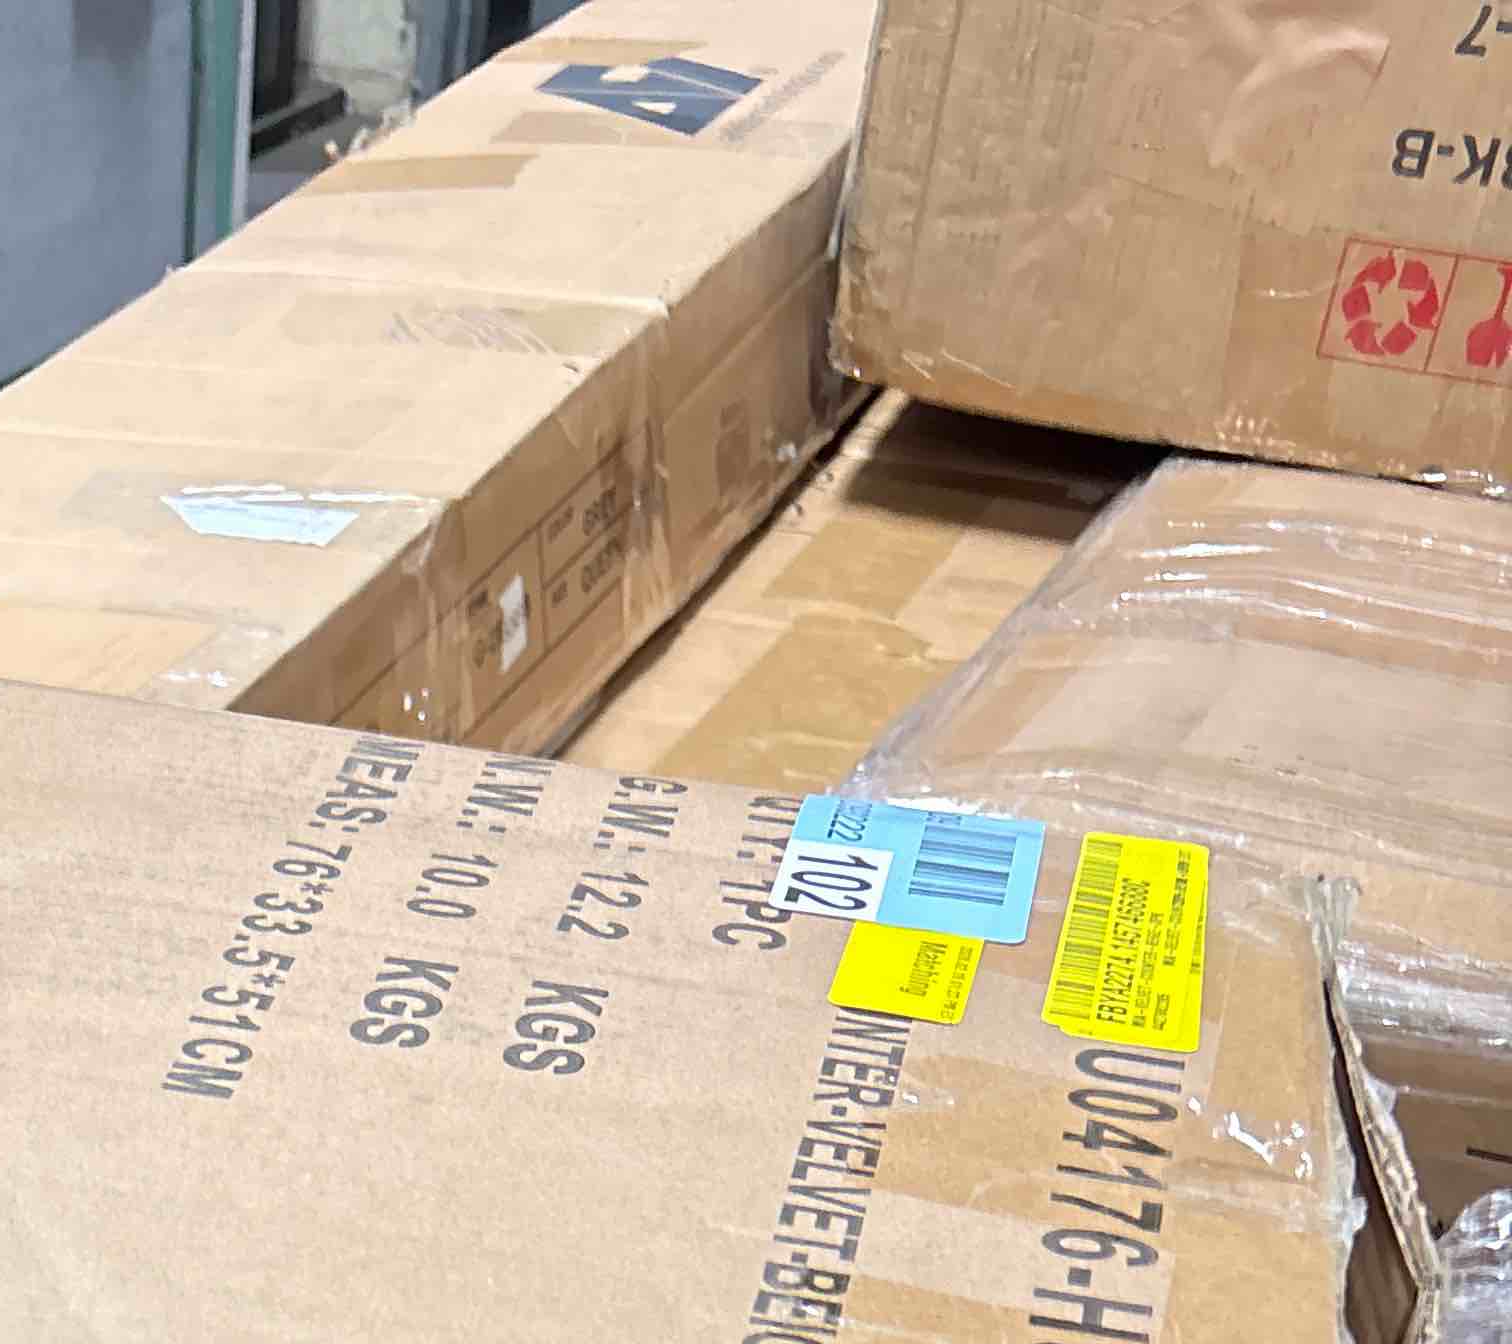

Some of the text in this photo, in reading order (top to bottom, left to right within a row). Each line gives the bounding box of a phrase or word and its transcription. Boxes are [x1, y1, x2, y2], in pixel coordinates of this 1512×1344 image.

[309, 734, 425, 834] MEAS:
[457, 753, 557, 834] N.W.:
[407, 852, 499, 920] 10.0
[502, 775, 687, 1076] G.W.: 12.2 KGS
[784, 853, 879, 912] 102
[350, 954, 460, 1049] KGS
